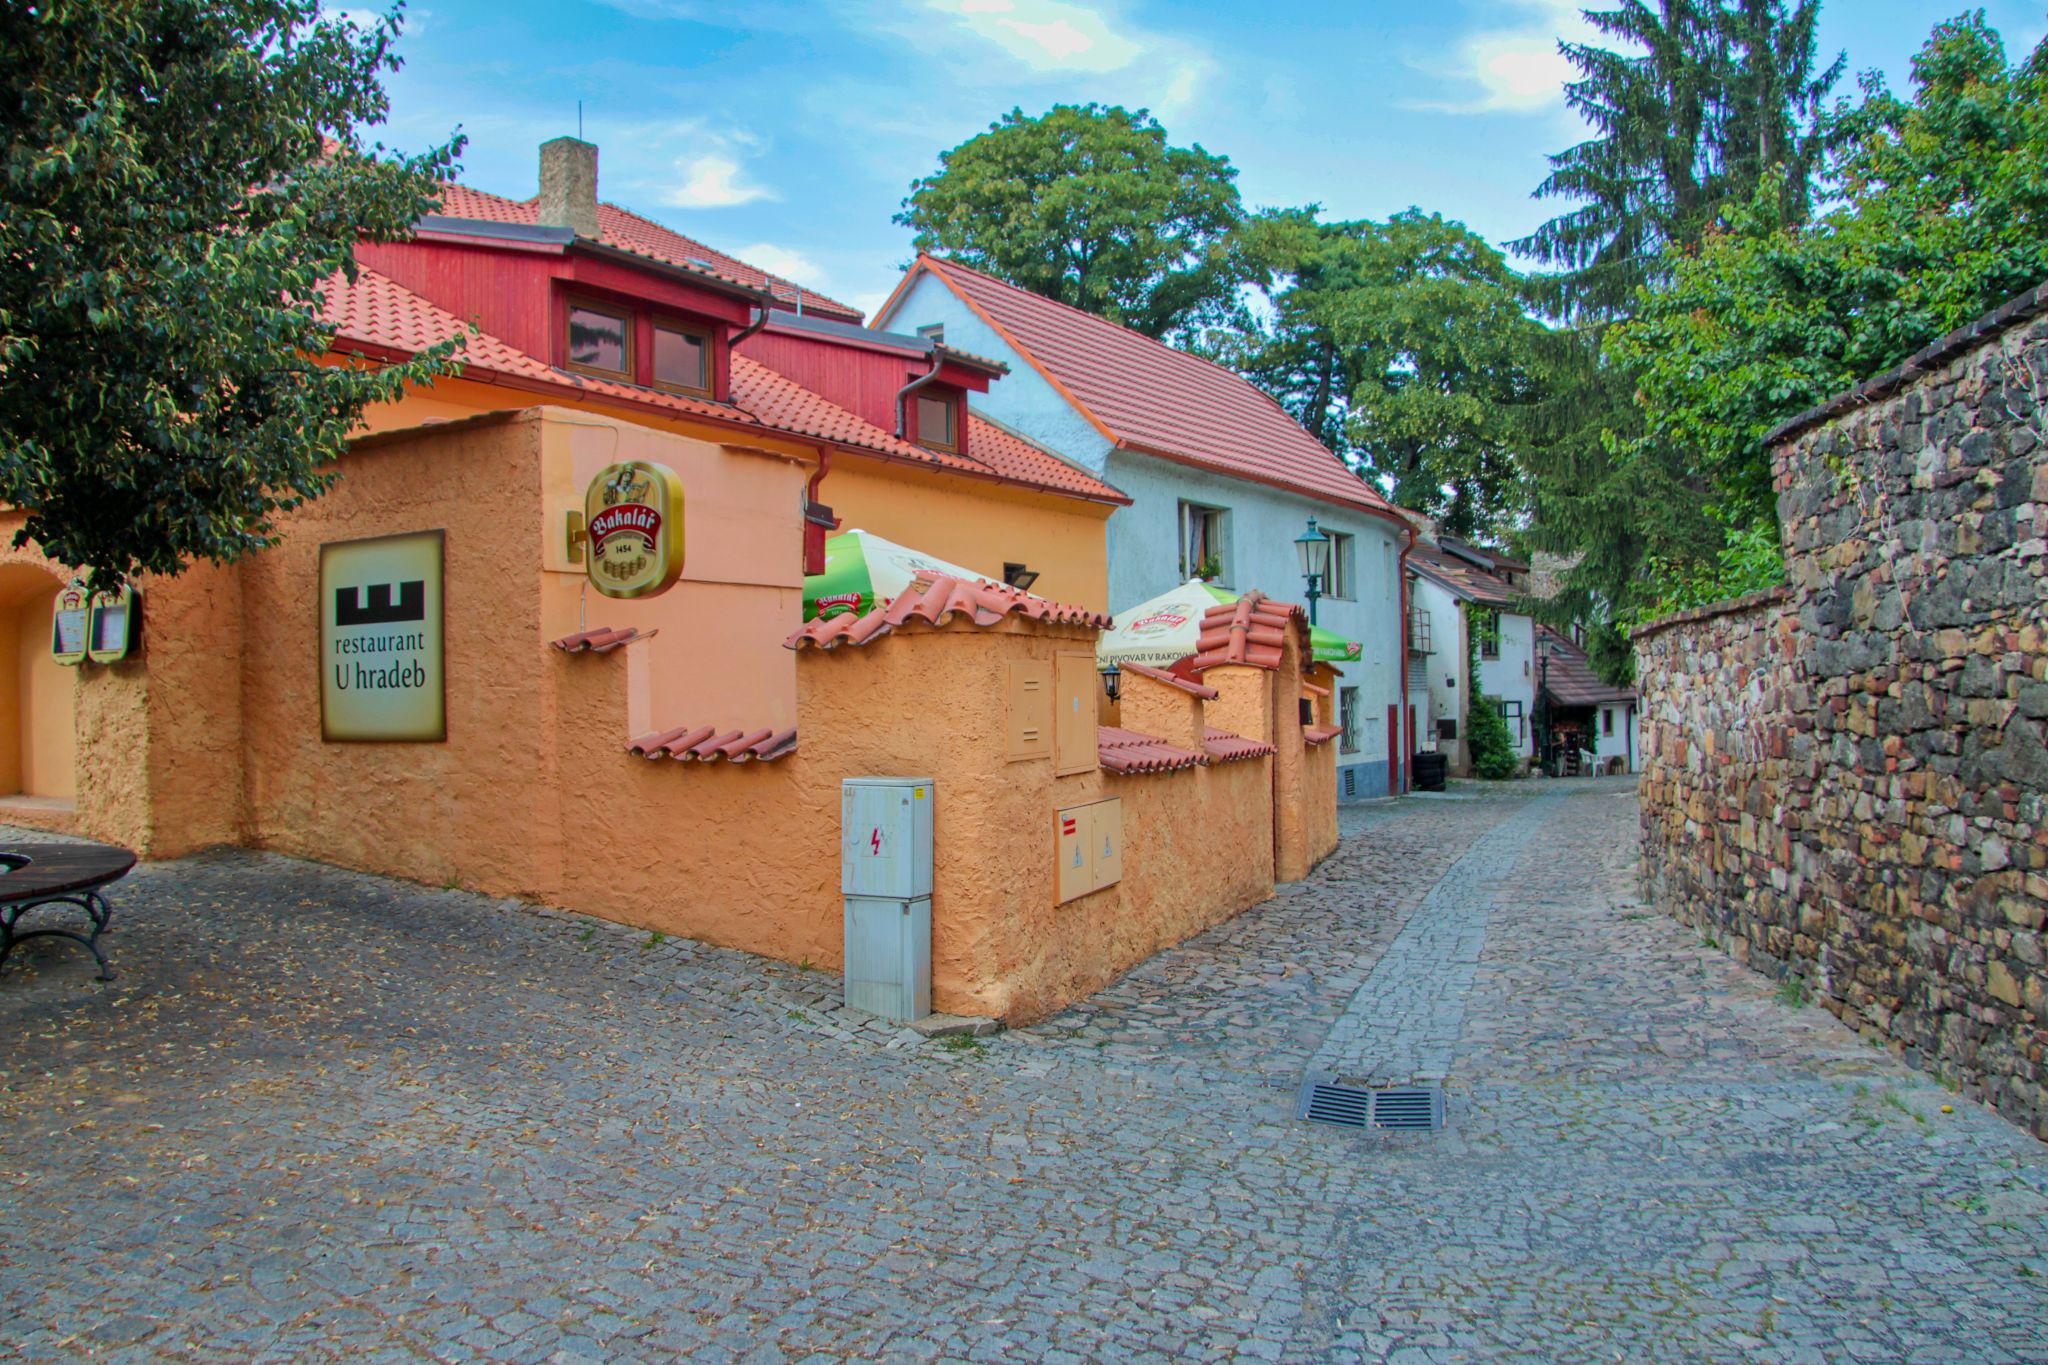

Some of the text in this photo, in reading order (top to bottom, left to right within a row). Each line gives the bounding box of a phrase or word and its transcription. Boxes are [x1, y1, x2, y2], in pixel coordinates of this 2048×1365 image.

[593, 508, 656, 535] Bakalář
[335, 631, 425, 654] restaurant
[335, 658, 426, 690] U hradeb
